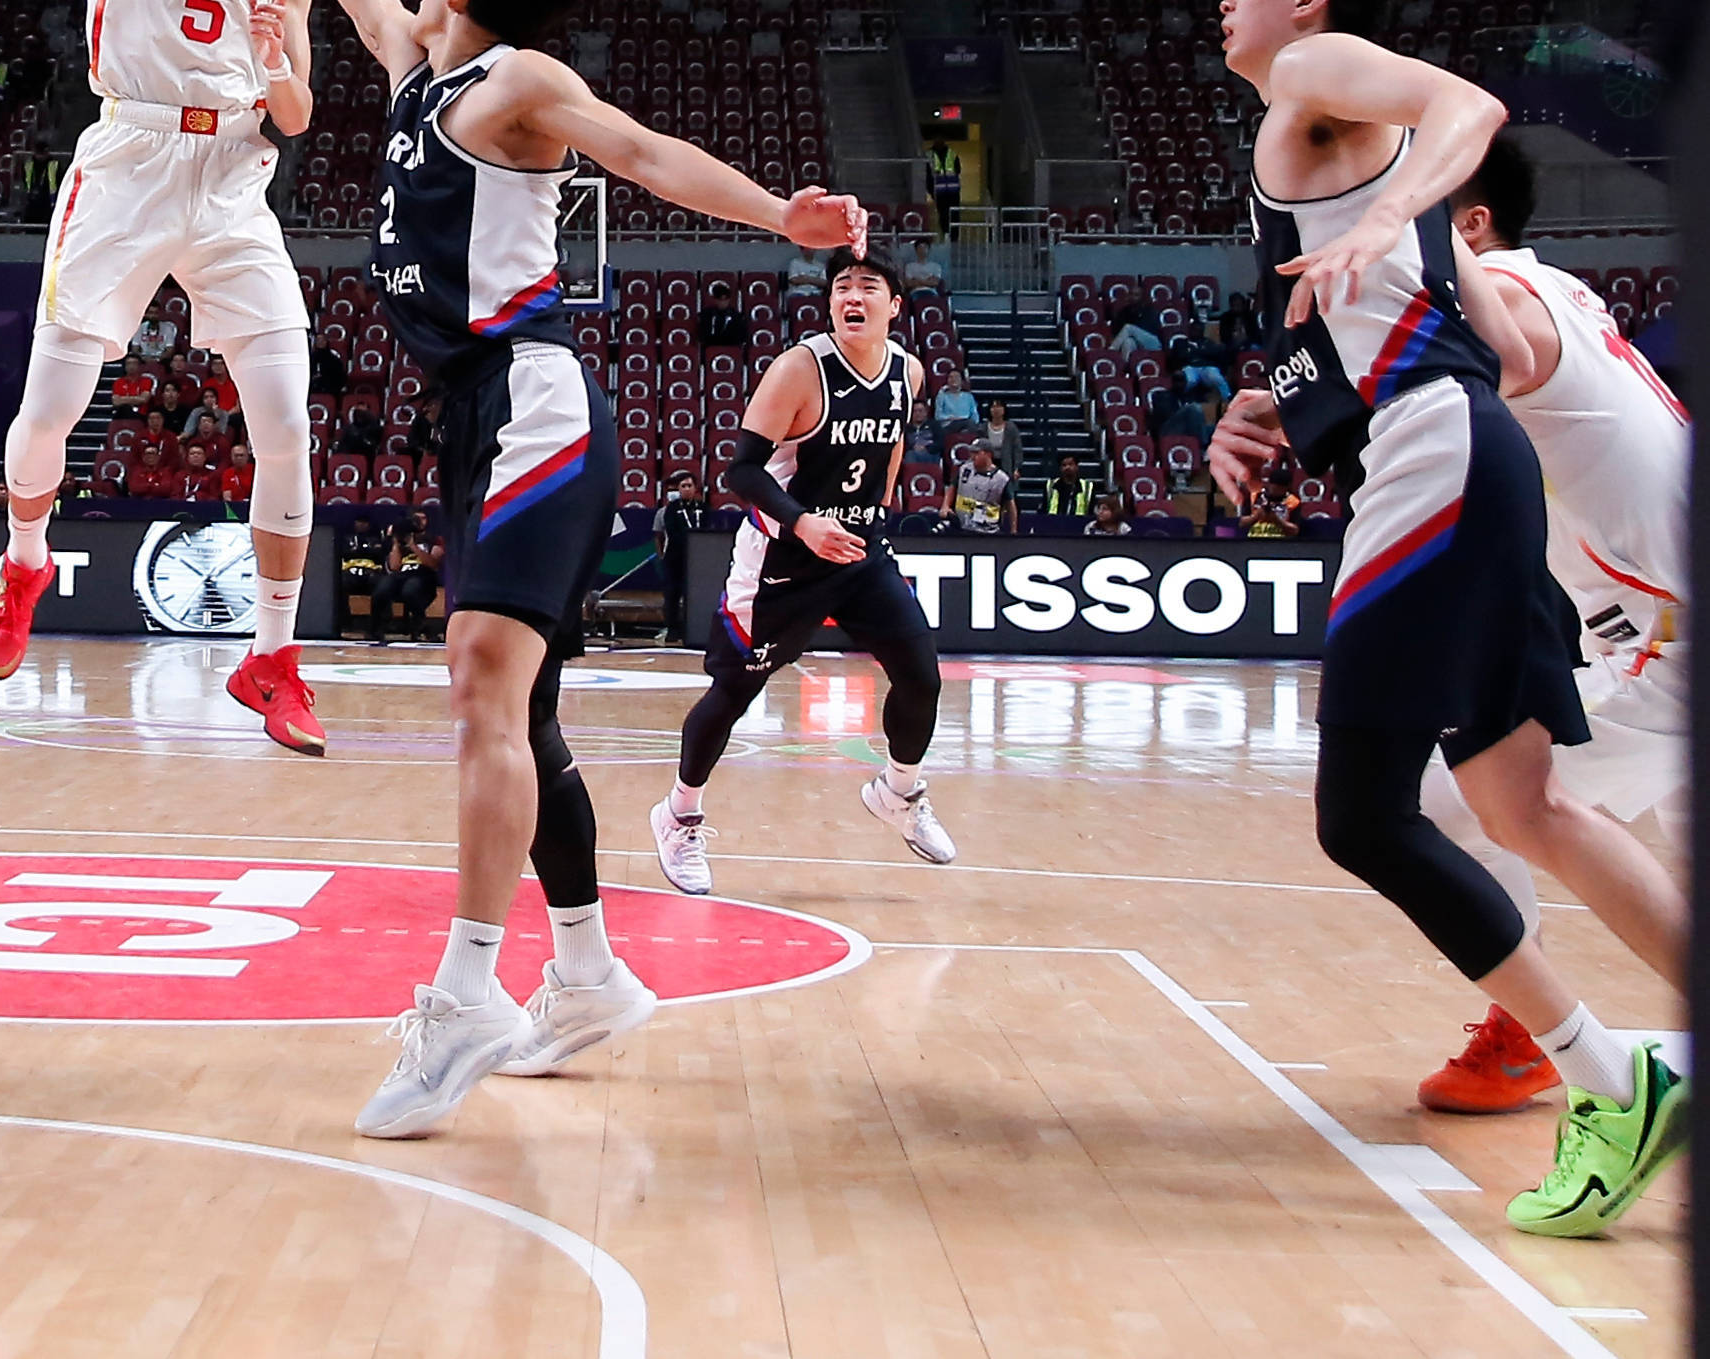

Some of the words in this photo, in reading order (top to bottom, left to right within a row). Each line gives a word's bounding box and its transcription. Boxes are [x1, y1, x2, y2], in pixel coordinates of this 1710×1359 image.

[830, 419, 901, 445] KOREA
[841, 458, 867, 493] 3
[893, 552, 1324, 636] TISSOT
